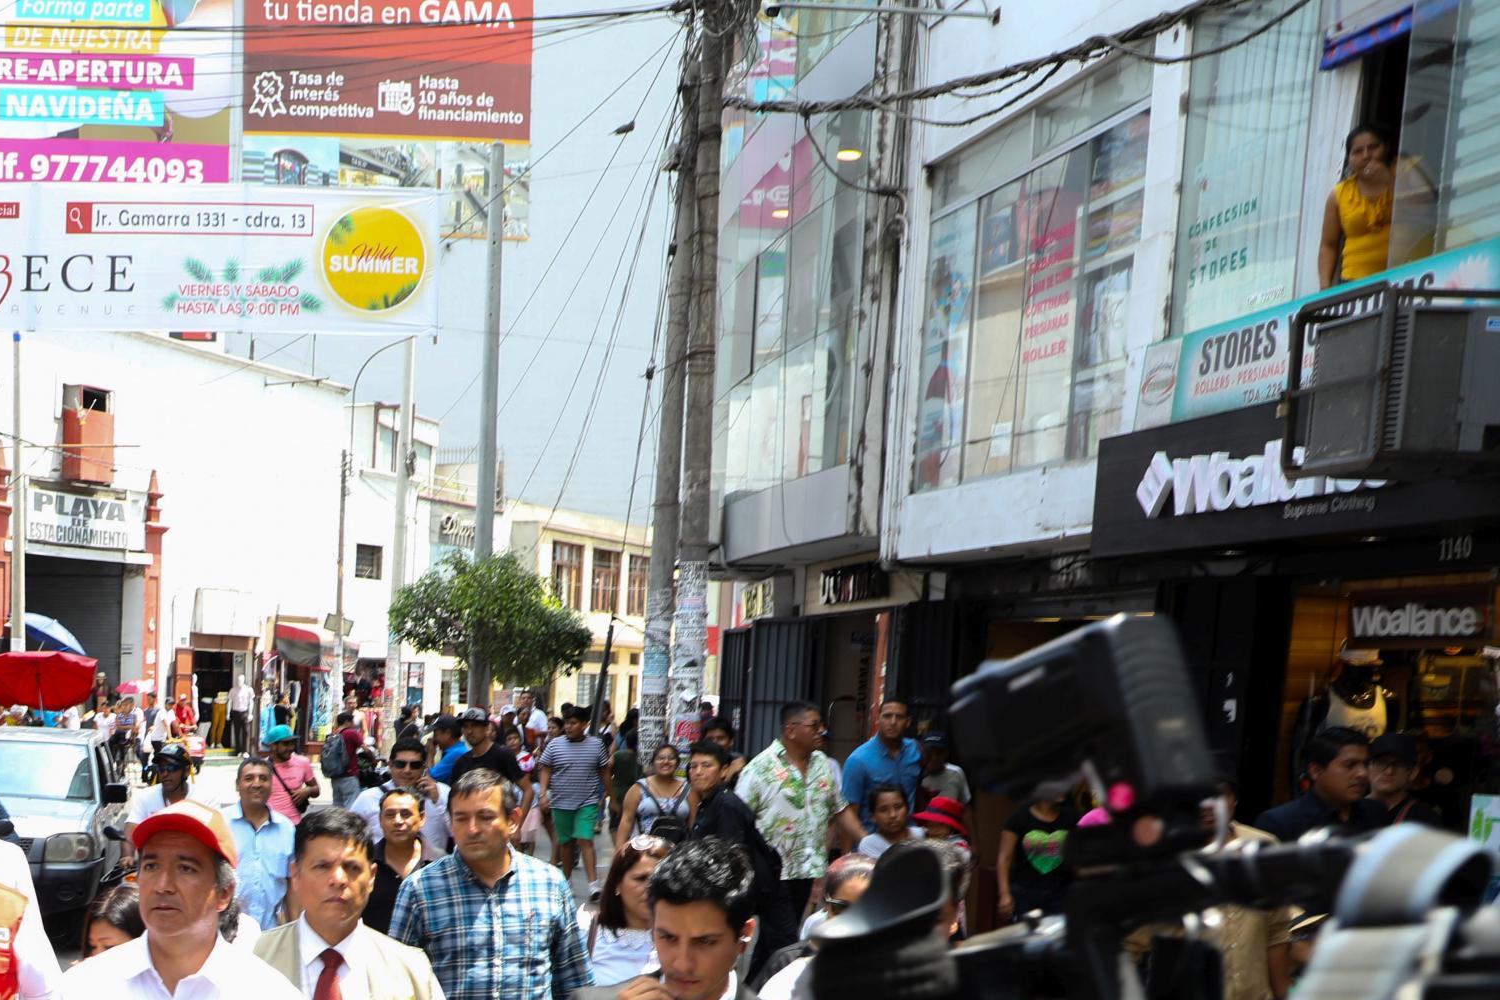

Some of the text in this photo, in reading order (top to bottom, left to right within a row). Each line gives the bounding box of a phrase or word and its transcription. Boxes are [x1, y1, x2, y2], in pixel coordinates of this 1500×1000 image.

[21, 0, 145, 20] Forma parte
[263, 0, 515, 29] tu tienda en GAMA
[13, 27, 153, 49] DE NUESTRA
[290, 70, 344, 86] Tasa de
[419, 75, 459, 90] Hasta
[290, 88, 340, 101] interés
[419, 91, 495, 107] 10 años de
[6, 92, 155, 121] NAVIDEÑA
[289, 103, 374, 119] competitiva
[418, 107, 524, 125] financiamiento
[31, 154, 204, 183] 977744093
[95, 210, 112, 227] Jr.
[118, 210, 190, 228] Gamarra
[196, 212, 226, 228] 1331
[245, 211, 285, 229] cdra.
[291, 213, 306, 229] 13
[351, 243, 400, 262] Wild
[1204, 236, 1218, 252] DE
[330, 255, 419, 275] SUMMER
[1189, 247, 1248, 289] STORES
[179, 285, 230, 297] VIERNES
[234, 285, 241, 297] Y
[177, 303, 300, 315] HASTA LAS 9:00 PM
[1022, 340, 1067, 365] ROLLER
[1199, 317, 1279, 377] STORES
[1194, 373, 1230, 398] ROLLERS
[1236, 359, 1286, 386] PERSIANAS
[33, 492, 126, 522] PLAYA
[1283, 495, 1376, 519] Supreme Clothing
[71, 518, 90, 528] DE
[29, 521, 128, 548] ESTACIONAMIENTO
[1438, 535, 1473, 561] 1140
[1351, 603, 1478, 637] Woallance
